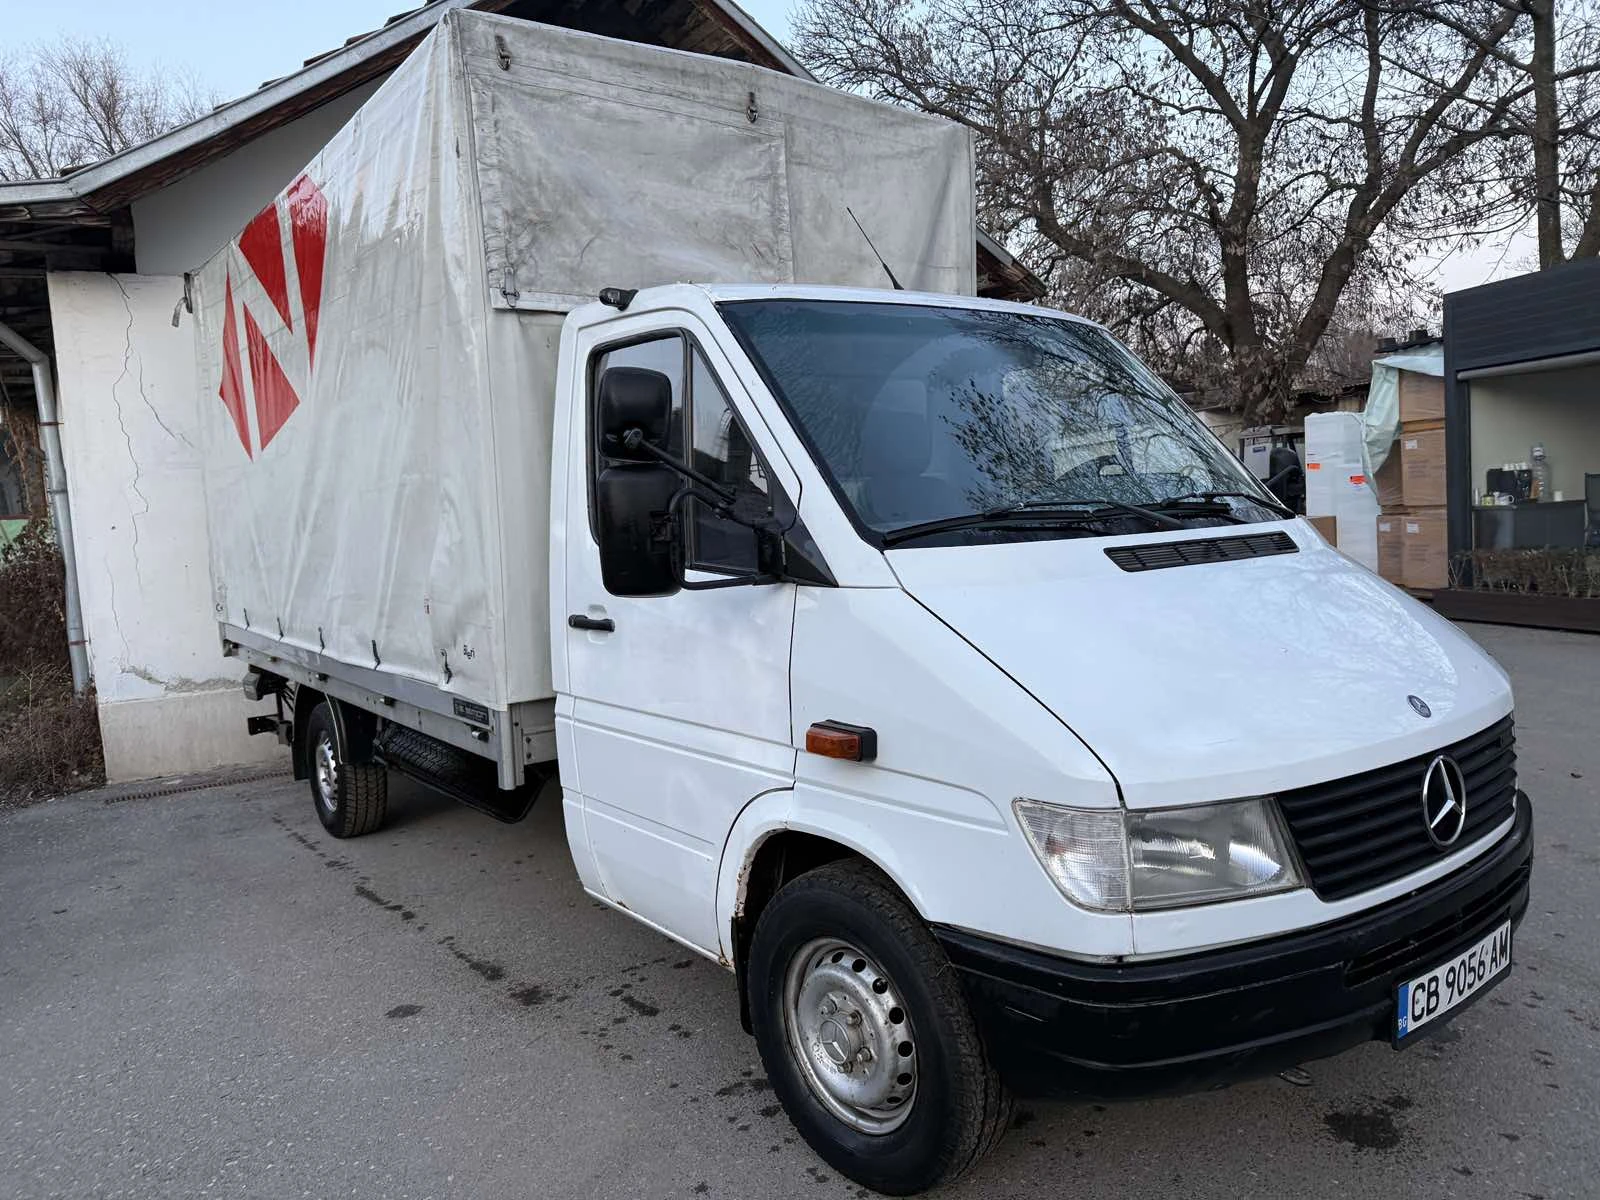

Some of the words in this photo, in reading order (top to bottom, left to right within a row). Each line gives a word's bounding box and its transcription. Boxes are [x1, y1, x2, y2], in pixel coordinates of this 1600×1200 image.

[1411, 975, 1440, 1023] CB
[1445, 944, 1486, 1006] 9056
[1489, 925, 1509, 974] AM
[1398, 1016, 1408, 1030] BG
